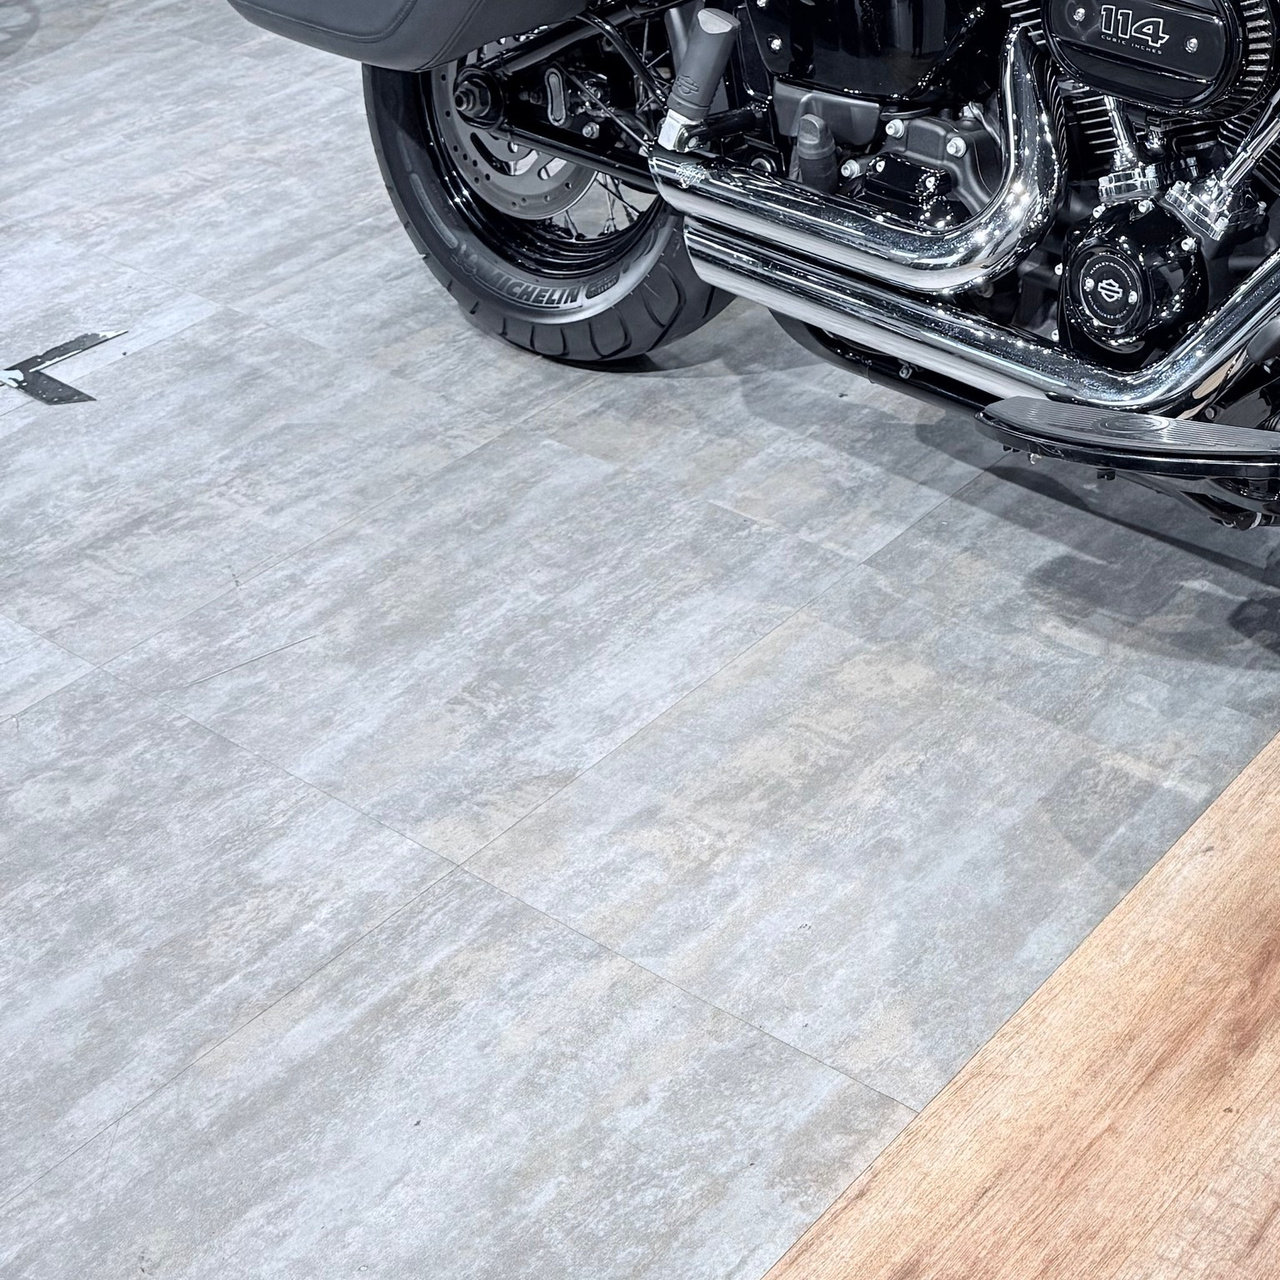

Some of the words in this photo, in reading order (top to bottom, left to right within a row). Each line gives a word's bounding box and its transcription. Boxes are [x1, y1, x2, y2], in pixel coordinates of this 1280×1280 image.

[1101, 5, 1170, 47] 114
[1101, 34, 1128, 47] CUBIC
[1131, 42, 1163, 55] INCHES
[492, 269, 582, 306] MICHELIN
